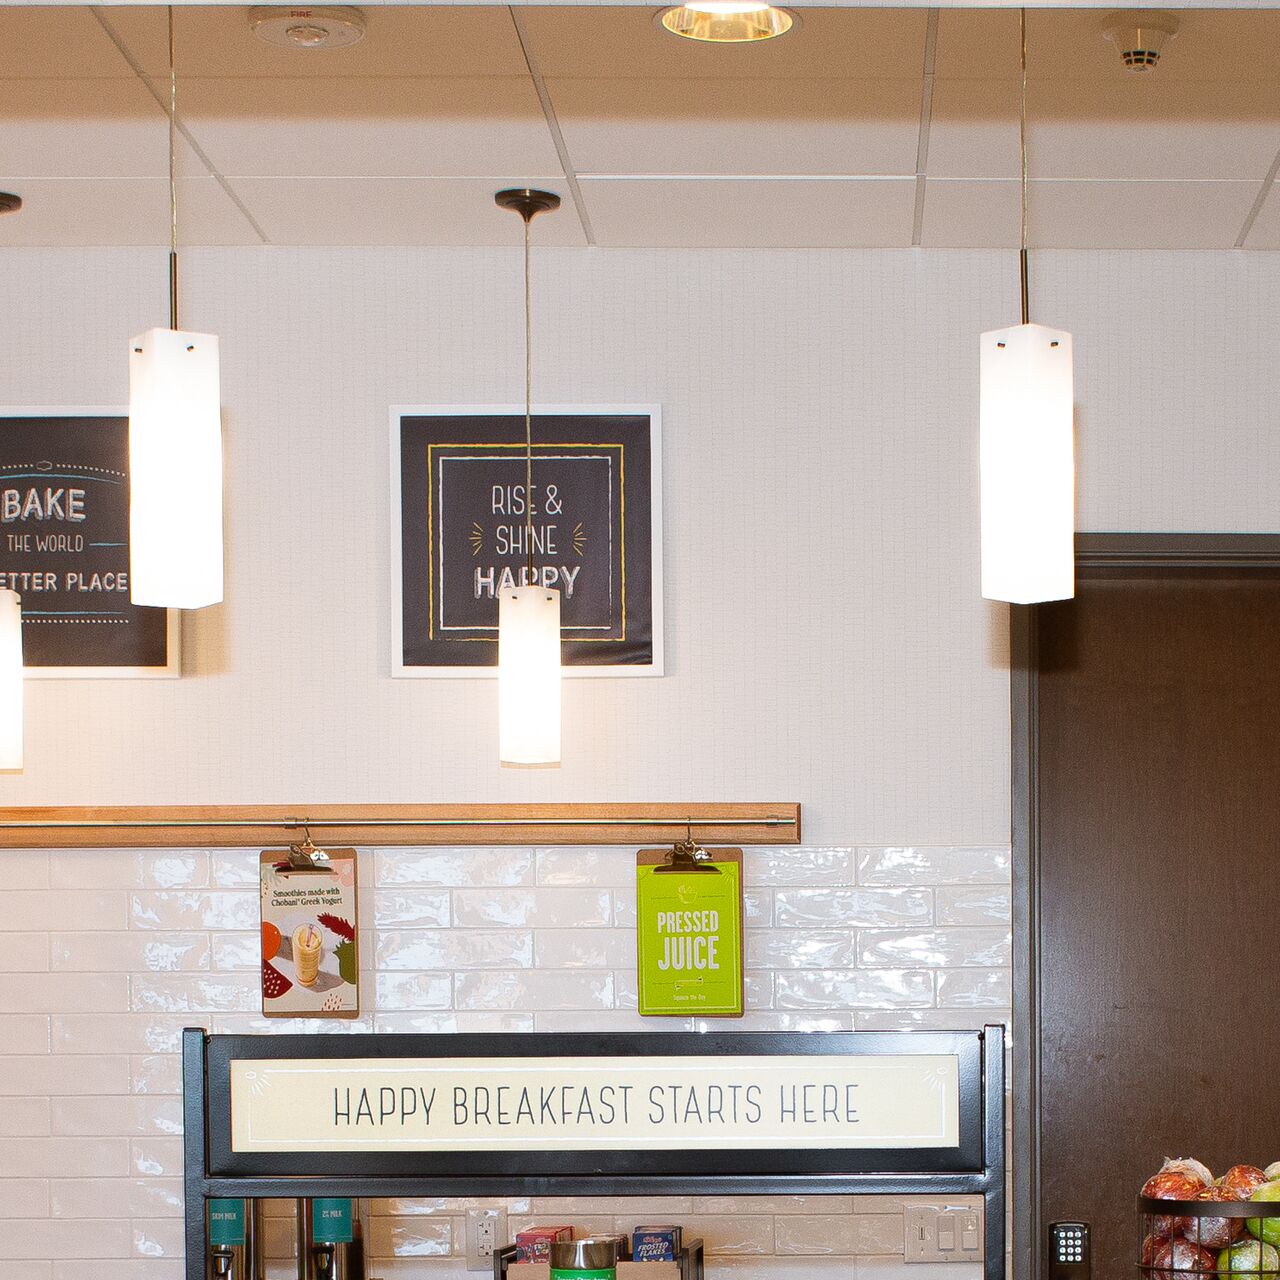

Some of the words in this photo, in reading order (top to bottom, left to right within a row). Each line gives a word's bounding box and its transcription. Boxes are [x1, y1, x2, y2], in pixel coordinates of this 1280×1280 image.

[1, 488, 87, 523] BAKE
[492, 485, 537, 515] RISE
[545, 484, 563, 515] &
[7, 534, 31, 552] THE
[36, 534, 84, 552] WORLD
[496, 525, 558, 555] SHINE
[66, 572, 129, 592] PLACE
[474, 566, 581, 599] HAPPY
[273, 889, 306, 897] Smoothies
[307, 888, 325, 896] made
[326, 887, 340, 895] with
[301, 898, 321, 906] Greek
[321, 897, 343, 906] Yogurt
[657, 910, 719, 933] PRESSED
[658, 935, 720, 970] JUICE
[334, 1087, 437, 1126] HAPPY
[453, 1086, 633, 1125] BREAKFAST
[649, 1085, 761, 1124] STARTS
[780, 1084, 860, 1123] HERE
[638, 1241, 669, 1252] FROSTED
[640, 1249, 666, 1257] FLAKES
